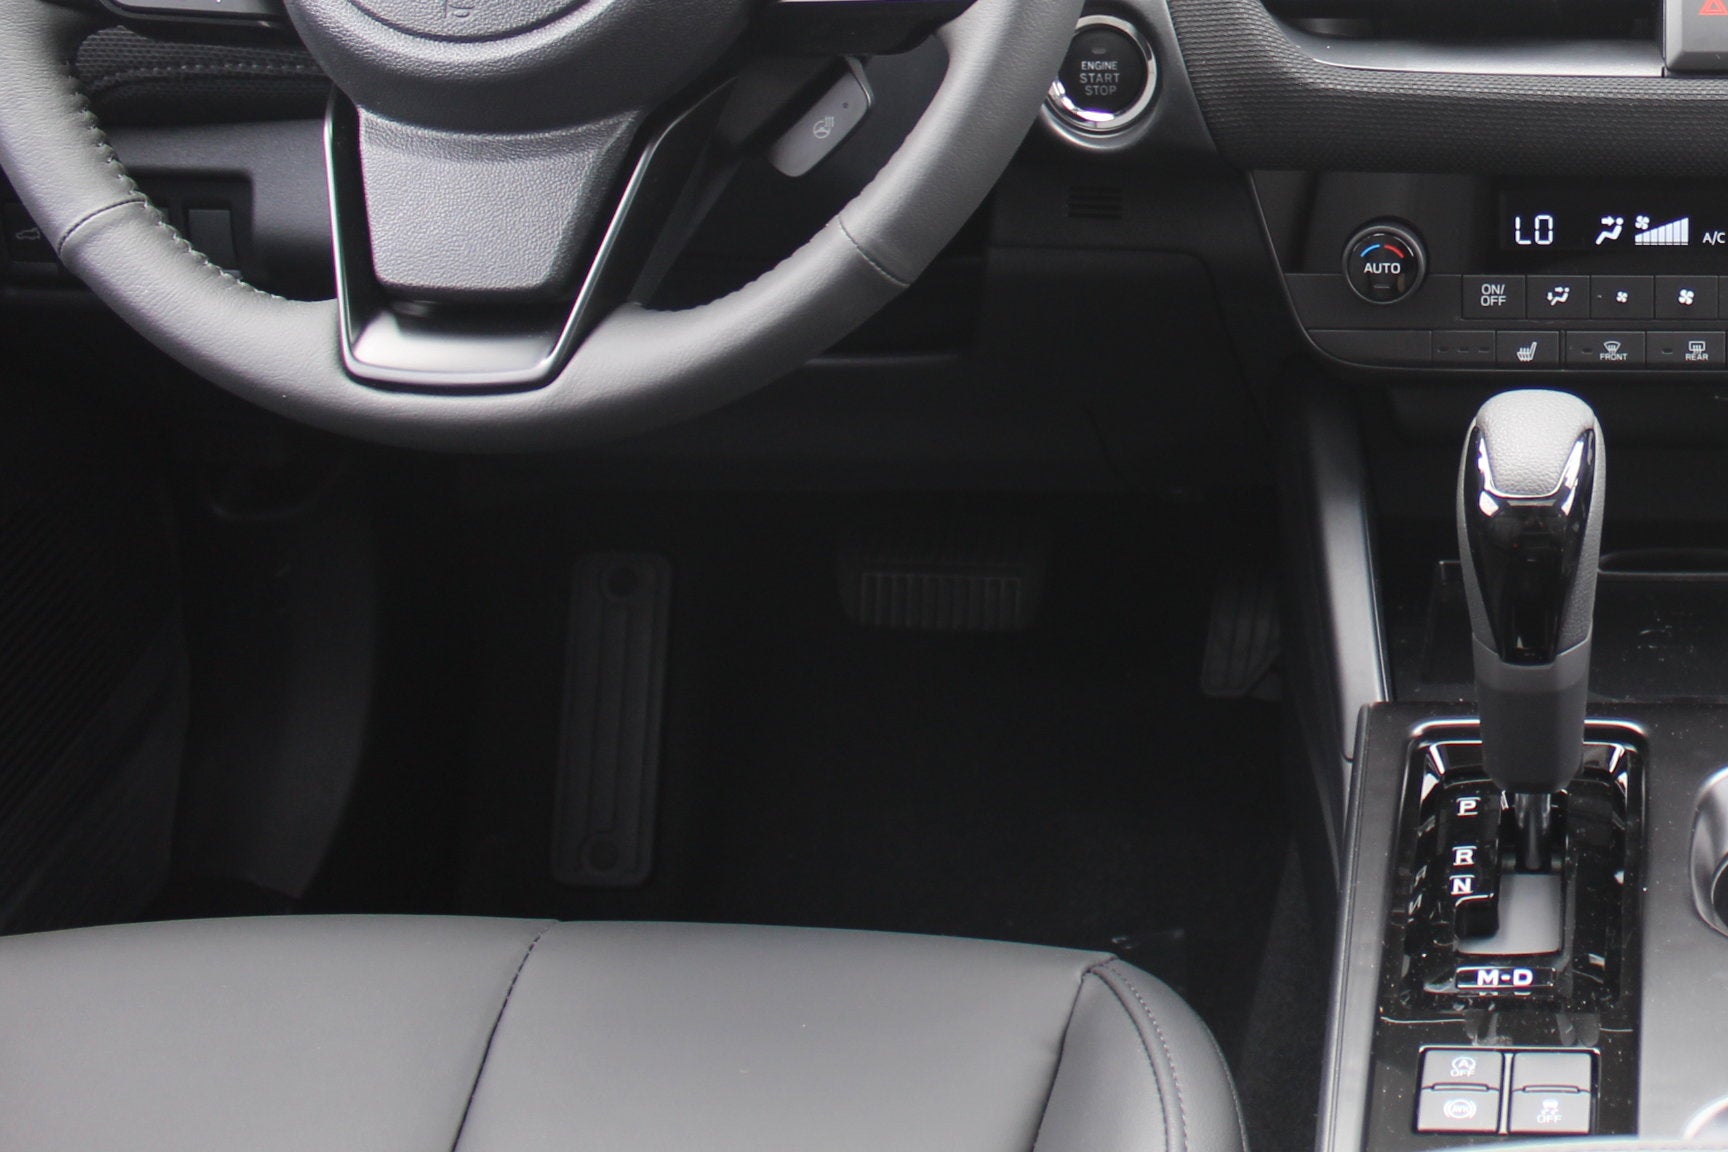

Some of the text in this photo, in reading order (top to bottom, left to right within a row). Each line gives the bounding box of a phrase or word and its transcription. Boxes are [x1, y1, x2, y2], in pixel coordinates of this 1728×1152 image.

[1081, 60, 1118, 71] ENGINE
[1080, 73, 1120, 84] START
[1085, 85, 1117, 96] STOP
[1515, 215, 1554, 246] LO
[1702, 231, 1726, 245] A/C
[1364, 263, 1401, 274] AUTO
[1481, 283, 1505, 296] ON/
[1480, 295, 1506, 307] OFF
[1600, 353, 1627, 361] FRONT
[1685, 353, 1709, 361] REAR
[1459, 800, 1477, 815] P
[1455, 849, 1474, 866] R
[1452, 878, 1471, 893] N
[1450, 1069, 1475, 1077] OFF
[1537, 1114, 1562, 1123] OFF
